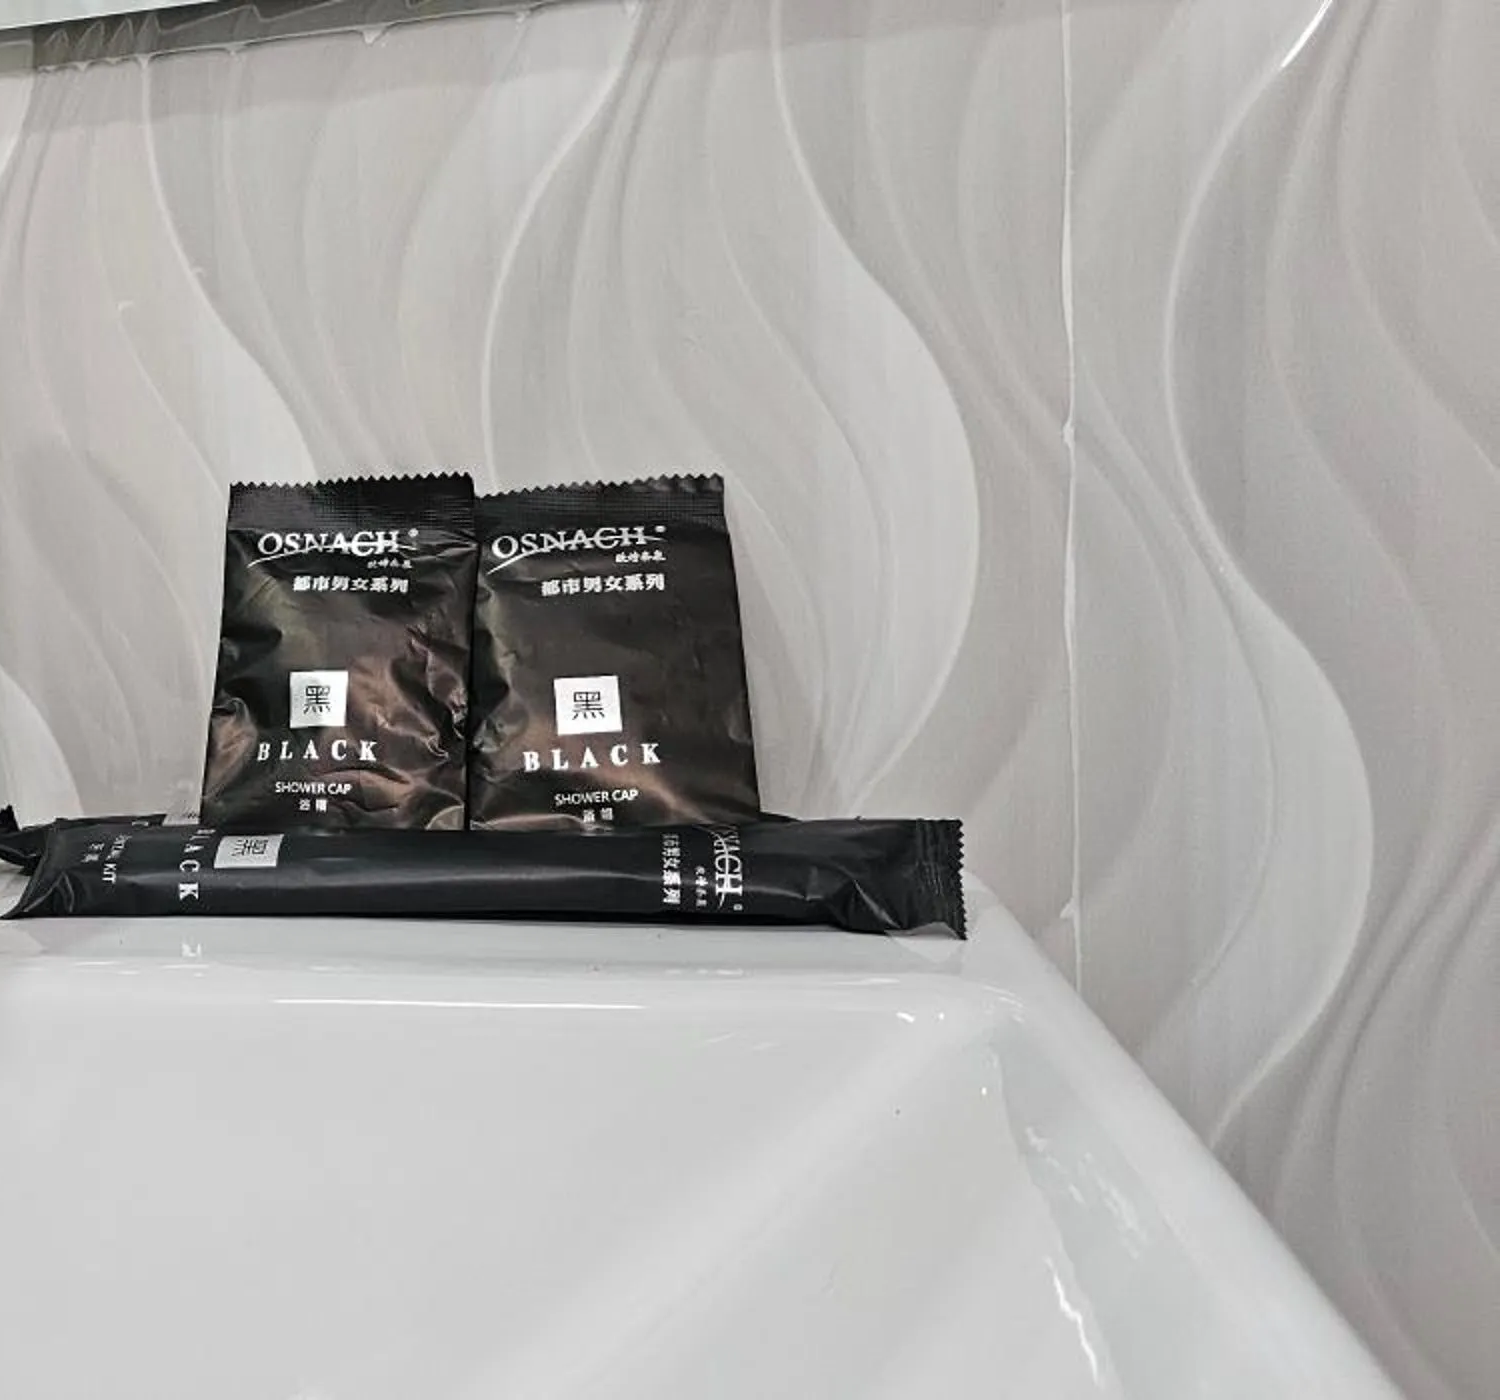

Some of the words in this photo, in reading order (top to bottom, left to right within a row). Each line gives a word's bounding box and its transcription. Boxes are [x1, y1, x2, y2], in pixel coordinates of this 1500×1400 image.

[257, 530, 400, 557] OSNACH
[490, 525, 647, 559] OSNACH
[292, 574, 410, 594] 都市男女系列
[540, 572, 666, 597] 都市男女系列
[303, 685, 331, 714] 黑
[572, 691, 605, 720] 黑
[256, 739, 378, 761] BLACK
[522, 743, 661, 772] BLACK
[275, 781, 327, 794] SHOWER
[327, 783, 353, 795] CAP
[554, 791, 609, 807] SHOWER
[611, 787, 639, 802] CAP
